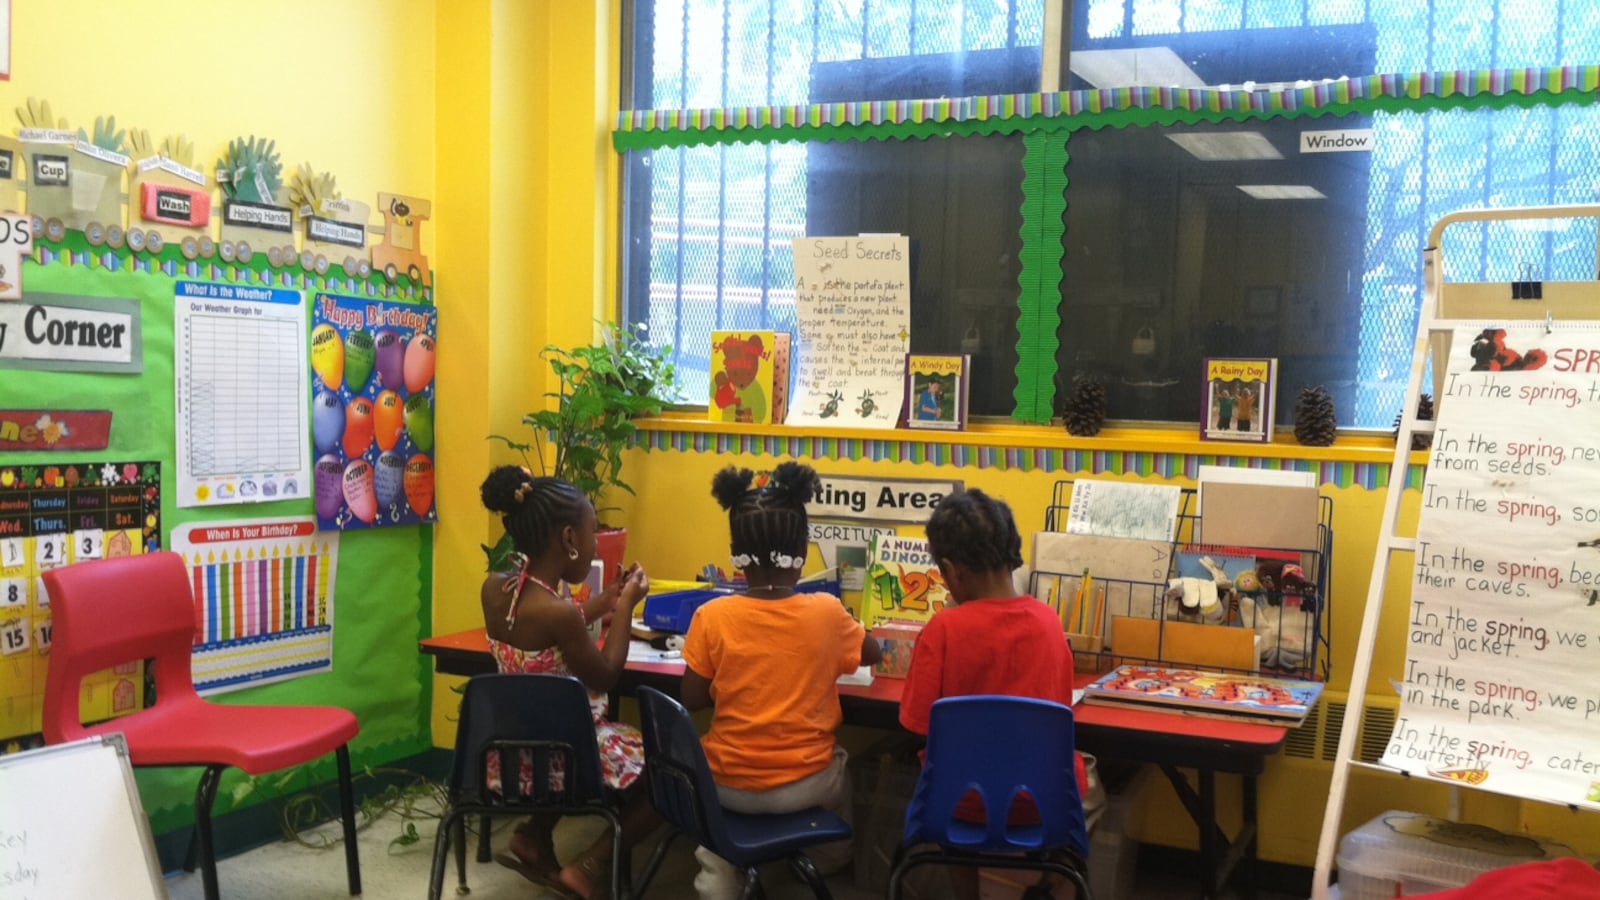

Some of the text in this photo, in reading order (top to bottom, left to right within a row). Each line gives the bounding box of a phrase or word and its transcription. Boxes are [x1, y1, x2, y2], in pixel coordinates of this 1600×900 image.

[1306, 133, 1368, 148] Window
[40, 164, 64, 177] Cup
[160, 198, 190, 212] Wash
[233, 208, 262, 222] Helping
[264, 211, 288, 223] Hands
[813, 240, 902, 260] Seed Secrets
[184, 283, 208, 295] What
[220, 286, 233, 297] the
[235, 287, 272, 300] Weather?
[796, 276, 805, 289] A
[190, 302, 202, 312] Our
[204, 304, 231, 314] Weather
[233, 306, 252, 316] Graph
[323, 299, 430, 335] Happy Birthday!
[25, 305, 125, 348] Corner
[312, 329, 336, 346] JANUARY
[920, 361, 944, 370] Windy
[945, 362, 961, 371] Day
[1211, 366, 1264, 376] A Rainy Day
[1553, 348, 1600, 374] SPR
[1445, 373, 1472, 397] In
[1480, 375, 1512, 398] the
[1518, 381, 1582, 408] spring,
[1435, 428, 1458, 452] In
[1468, 433, 1497, 453] the
[1506, 437, 1566, 465] spring,
[346, 463, 368, 482] OCTOBER
[1433, 452, 1551, 476] from seeds.
[33, 498, 66, 508] Thursday
[77, 495, 99, 506] Friday
[110, 494, 139, 504] Saturday
[808, 484, 944, 512] ting Area
[1425, 484, 1449, 510] In
[1456, 488, 1487, 512] the
[1497, 495, 1561, 526] spring,
[33, 516, 66, 531] Thurs.
[115, 512, 134, 525] Sat.
[206, 524, 298, 541] When Is Your Birthday?
[44, 542, 54, 559] 2
[83, 538, 93, 555] 3
[882, 539, 890, 549] A
[1417, 542, 1445, 568] In
[1451, 547, 1485, 572] the
[1497, 557, 1563, 589] spring,
[875, 571, 929, 611] 1 2
[1416, 567, 1530, 597] their caves.
[8, 585, 18, 602] 8
[1411, 601, 1438, 629] In
[1446, 606, 1478, 632] the
[1556, 631, 1587, 648] we
[6, 628, 24, 648] 15
[1411, 629, 1519, 660] and jacket.
[1405, 659, 1429, 686] In
[1435, 665, 1466, 692] the
[1474, 678, 1543, 712] spring,
[1548, 692, 1577, 710] we
[1407, 689, 1520, 723] in the park.
[1395, 718, 1419, 742] In
[1429, 725, 1460, 750] the
[1467, 740, 1533, 770] spring,
[1389, 743, 1491, 770] a butterfly
